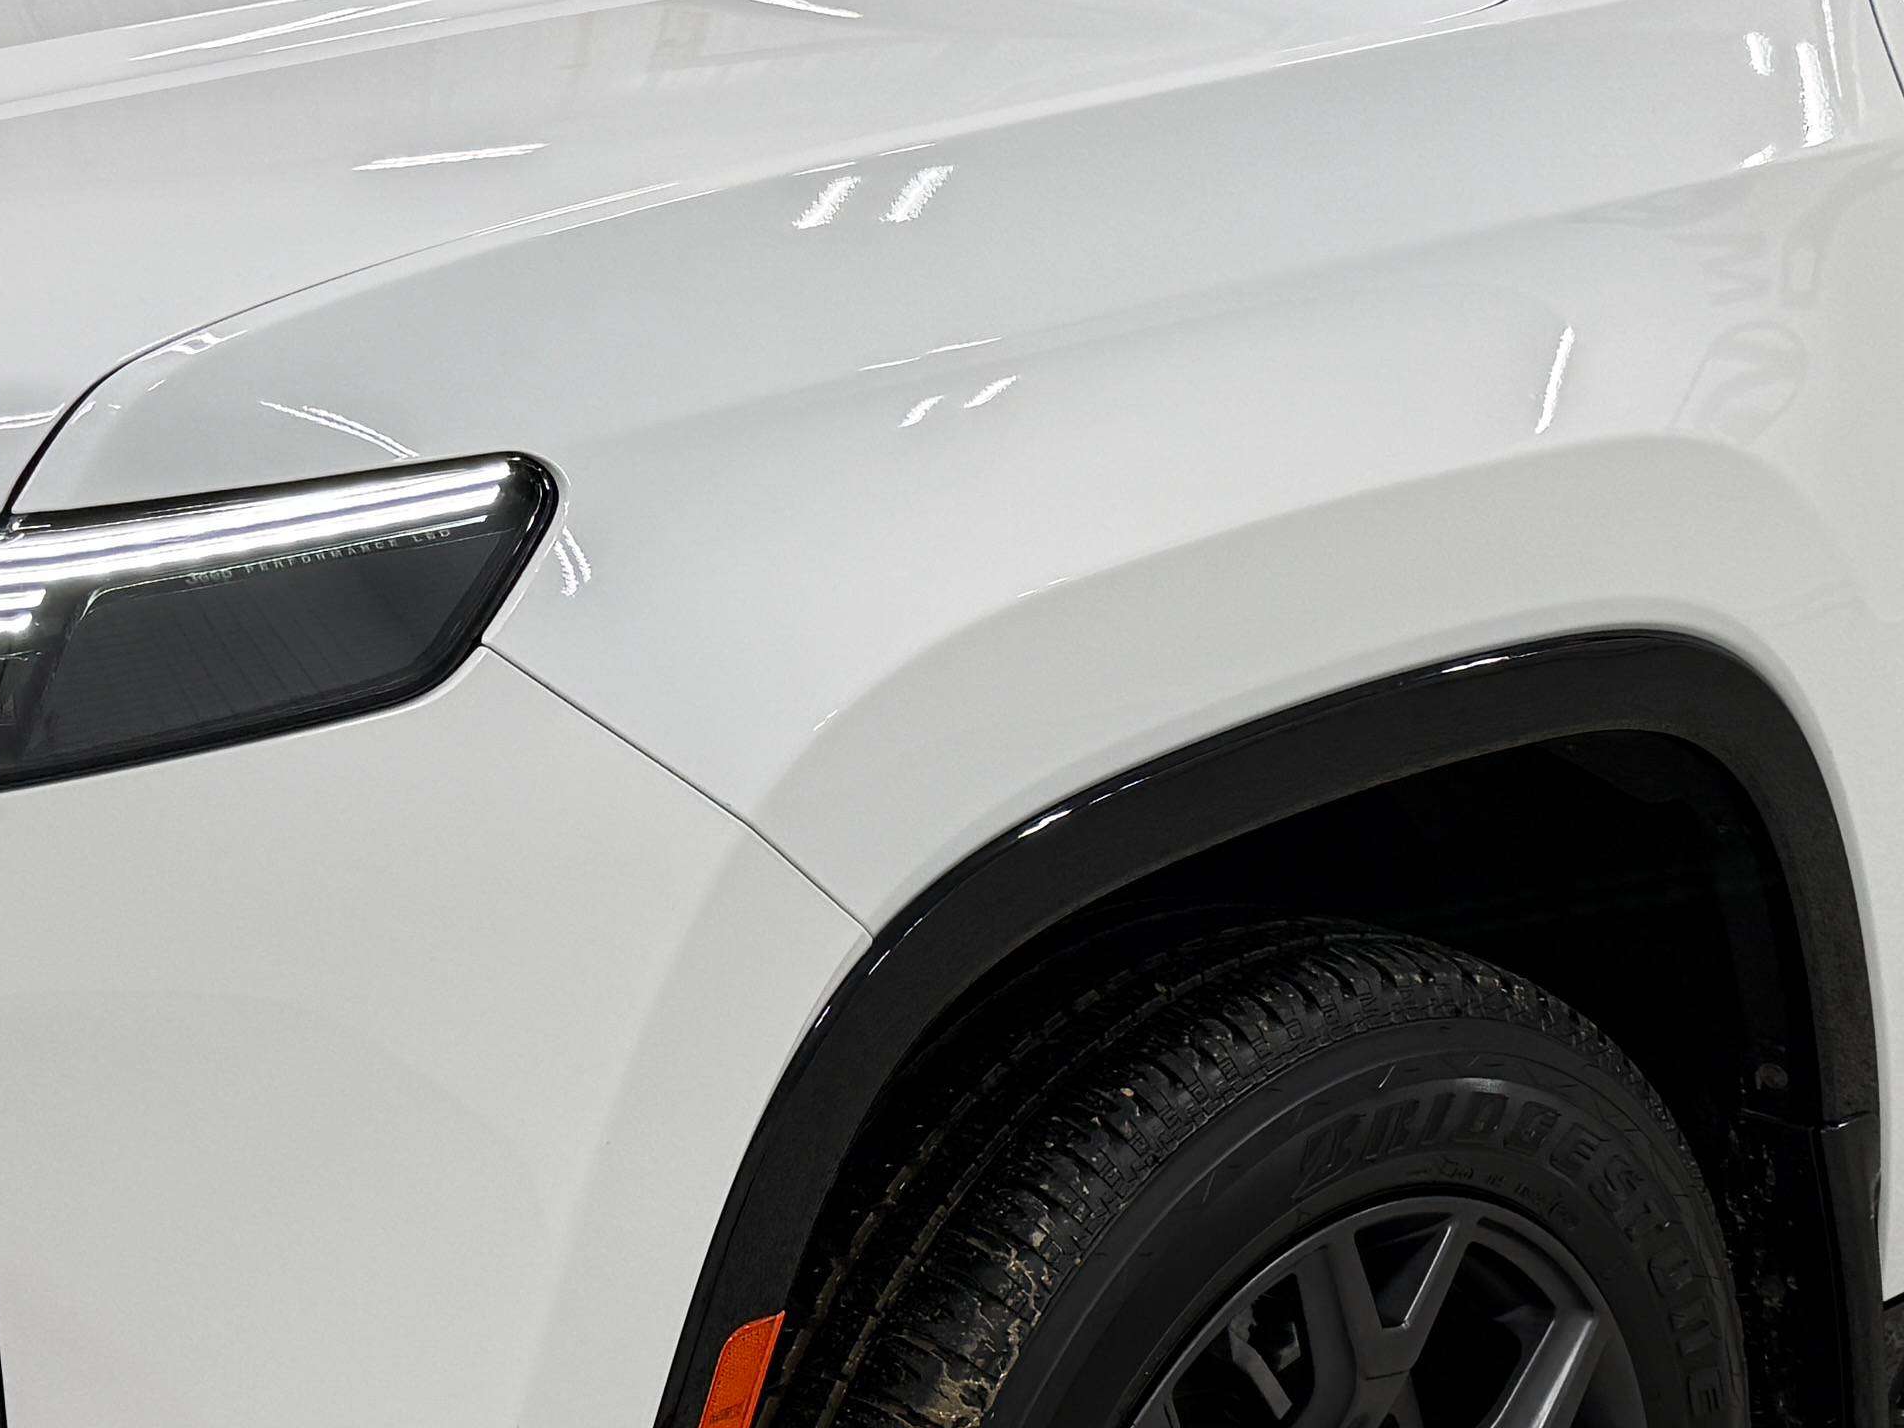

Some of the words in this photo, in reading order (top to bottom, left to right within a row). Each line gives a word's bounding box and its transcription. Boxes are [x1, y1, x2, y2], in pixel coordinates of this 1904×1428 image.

[246, 539, 398, 574] PERFORMANCE
[412, 528, 451, 543] LED
[1291, 1091, 1723, 1419] BRIDGESTONE
